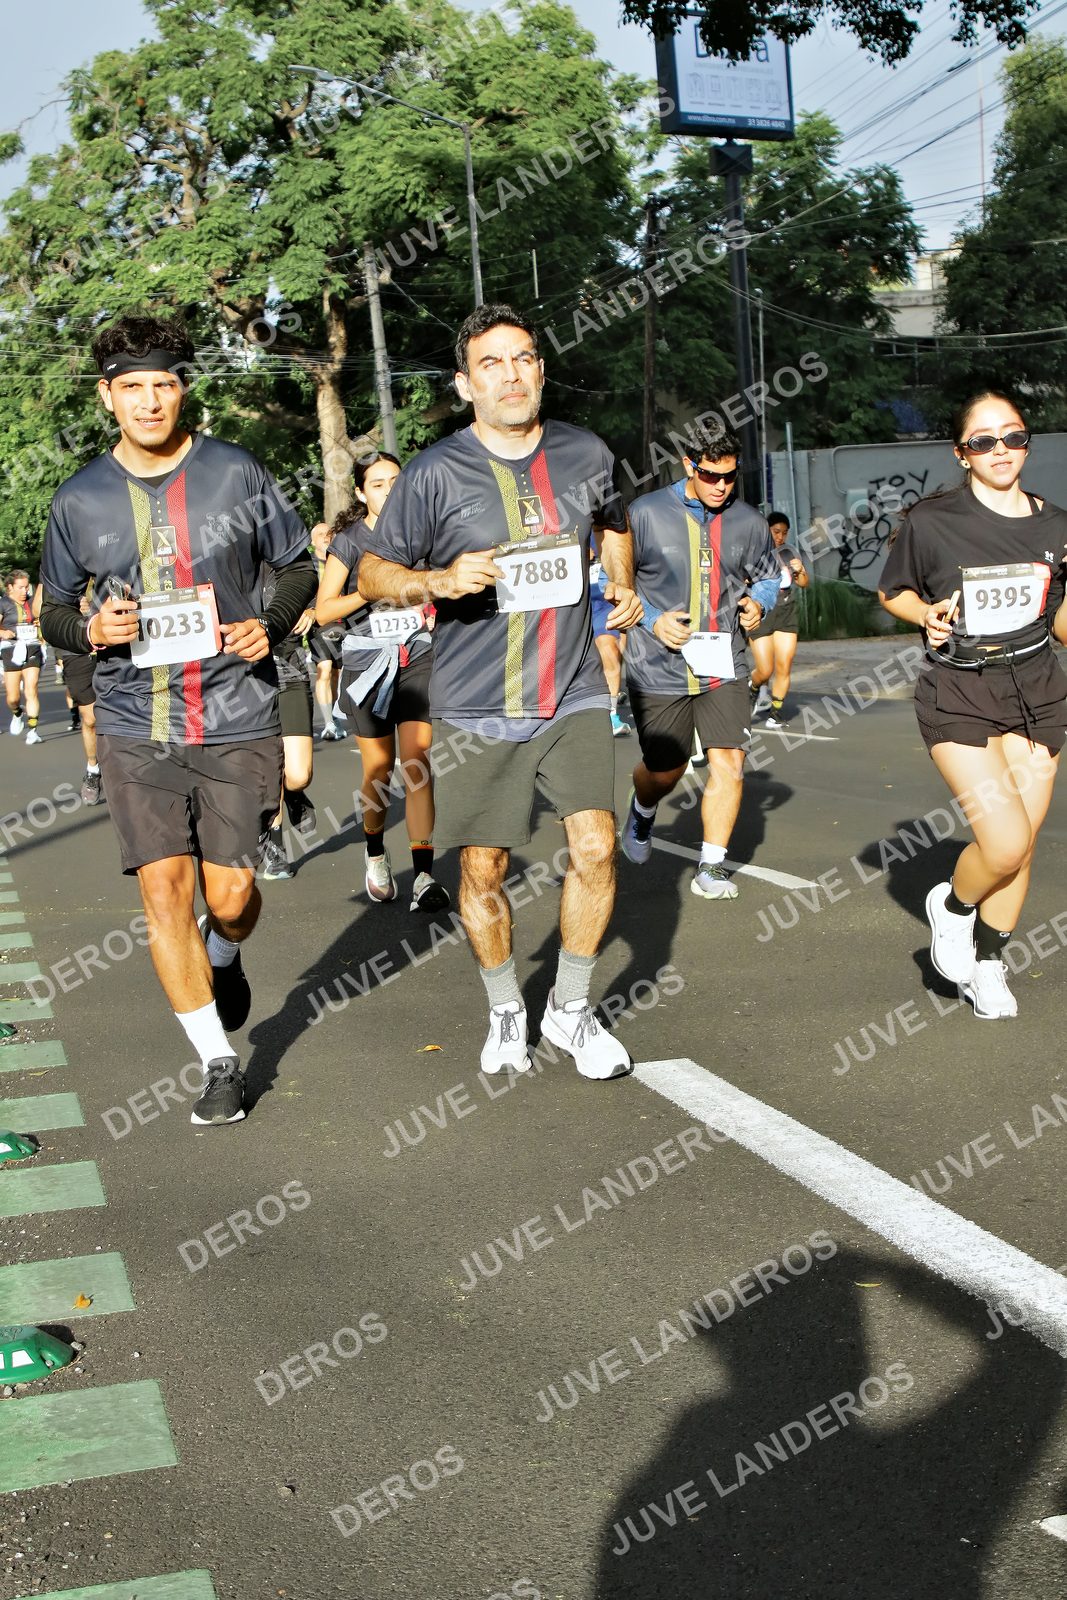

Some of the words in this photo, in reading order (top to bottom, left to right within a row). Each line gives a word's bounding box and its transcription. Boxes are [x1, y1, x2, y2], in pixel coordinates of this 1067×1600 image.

[868, 469, 929, 493] TOY
[510, 557, 568, 586] 7888
[975, 585, 1031, 610] 9395
[138, 610, 206, 641] 10233
[375, 616, 418, 633] 12733
